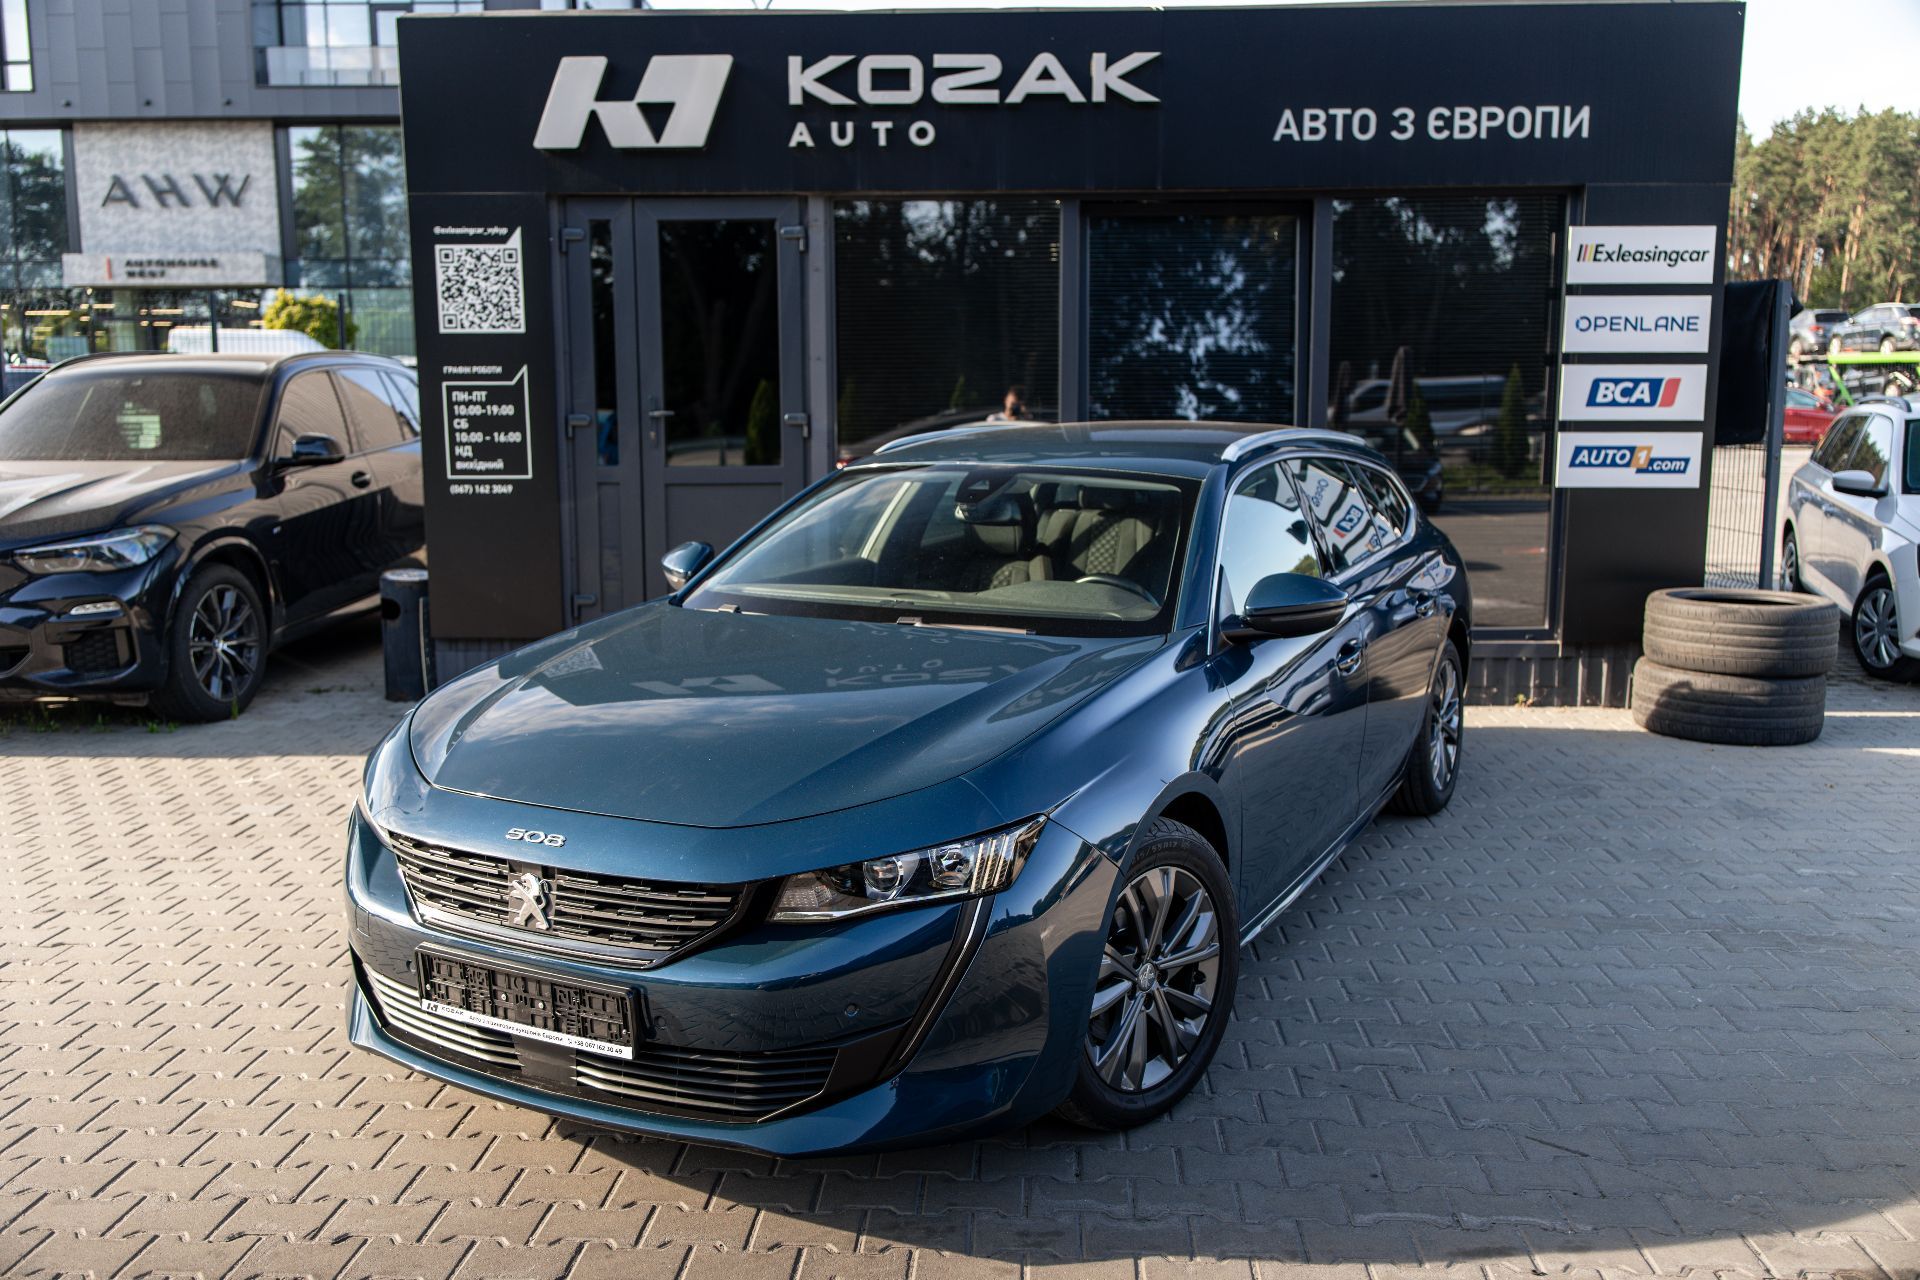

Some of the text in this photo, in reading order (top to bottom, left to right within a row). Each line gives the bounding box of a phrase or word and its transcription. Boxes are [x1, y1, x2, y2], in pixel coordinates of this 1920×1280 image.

[788, 51, 1162, 105] KOZAK
[1273, 107, 1378, 142] АВТО
[1427, 105, 1591, 141] ЄВРОПИ
[788, 120, 936, 148] AUTO
[102, 173, 250, 208] AHW
[1592, 244, 1710, 267] Exleasingcar
[1576, 316, 1700, 333] OPENLANE
[452, 391, 488, 402] ПН-ПТ
[1595, 381, 1651, 404] BCA
[454, 405, 515, 416] 10:00-19:00
[453, 418, 469, 429] СБ
[455, 432, 484, 443] 10:00
[493, 432, 522, 443] 16:00
[455, 445, 473, 458] НД
[505, 827, 567, 847] 508
